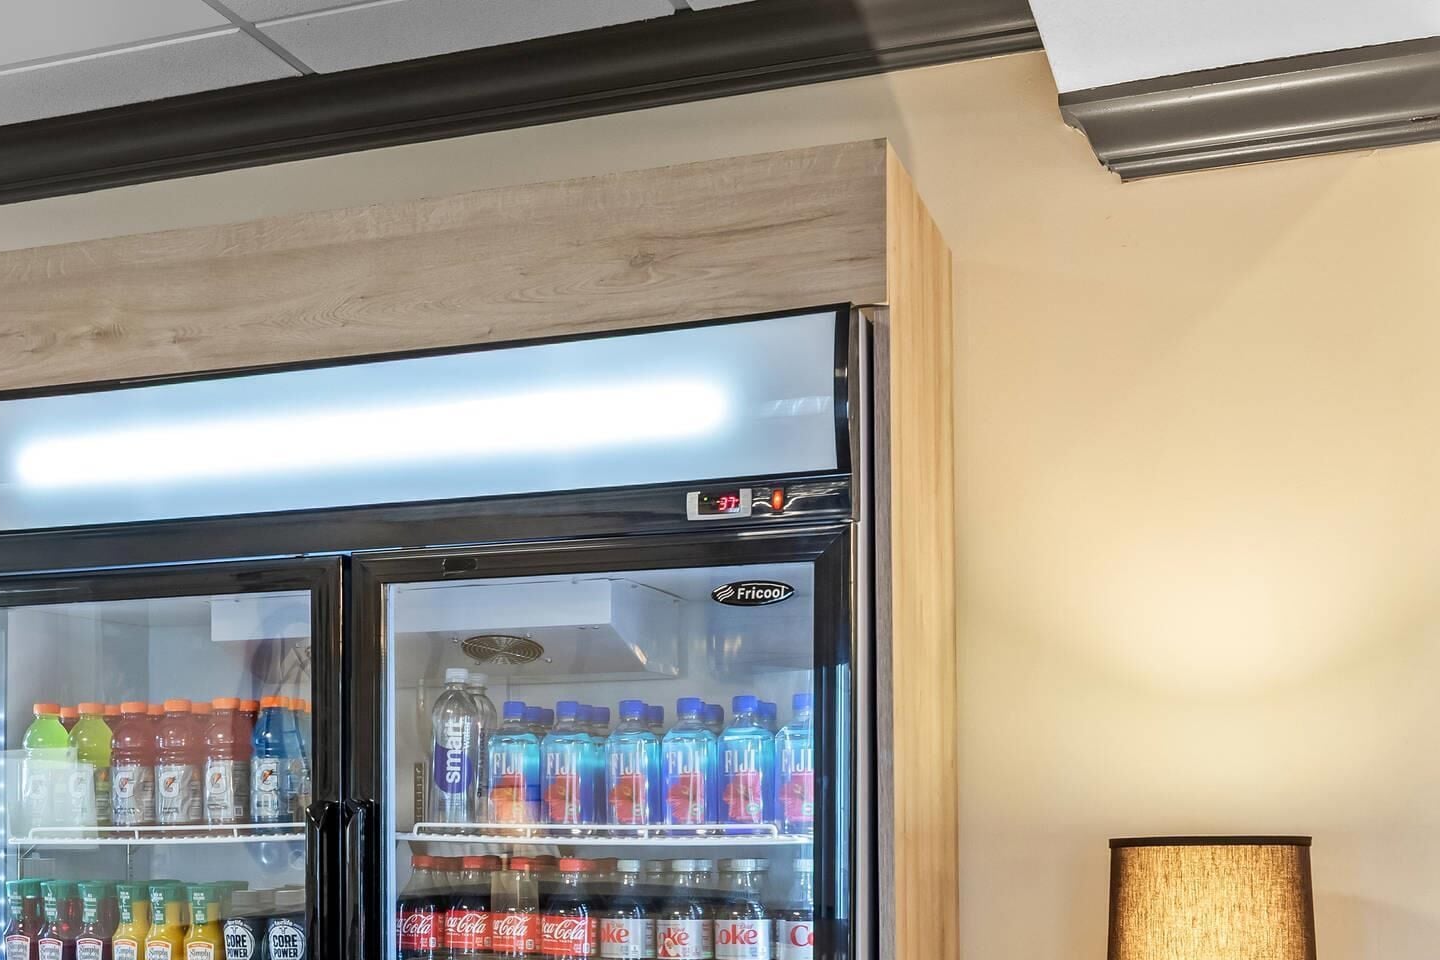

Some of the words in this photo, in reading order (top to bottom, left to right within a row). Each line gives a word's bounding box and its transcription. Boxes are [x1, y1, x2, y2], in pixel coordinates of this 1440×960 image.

[736, 585, 785, 601] Fricool
[445, 716, 463, 784] smart
[724, 749, 757, 773] FIJI
[226, 934, 247, 948] CORE
[272, 934, 298, 948] CORE
[227, 948, 248, 958] POWER
[274, 948, 298, 958] POWER
